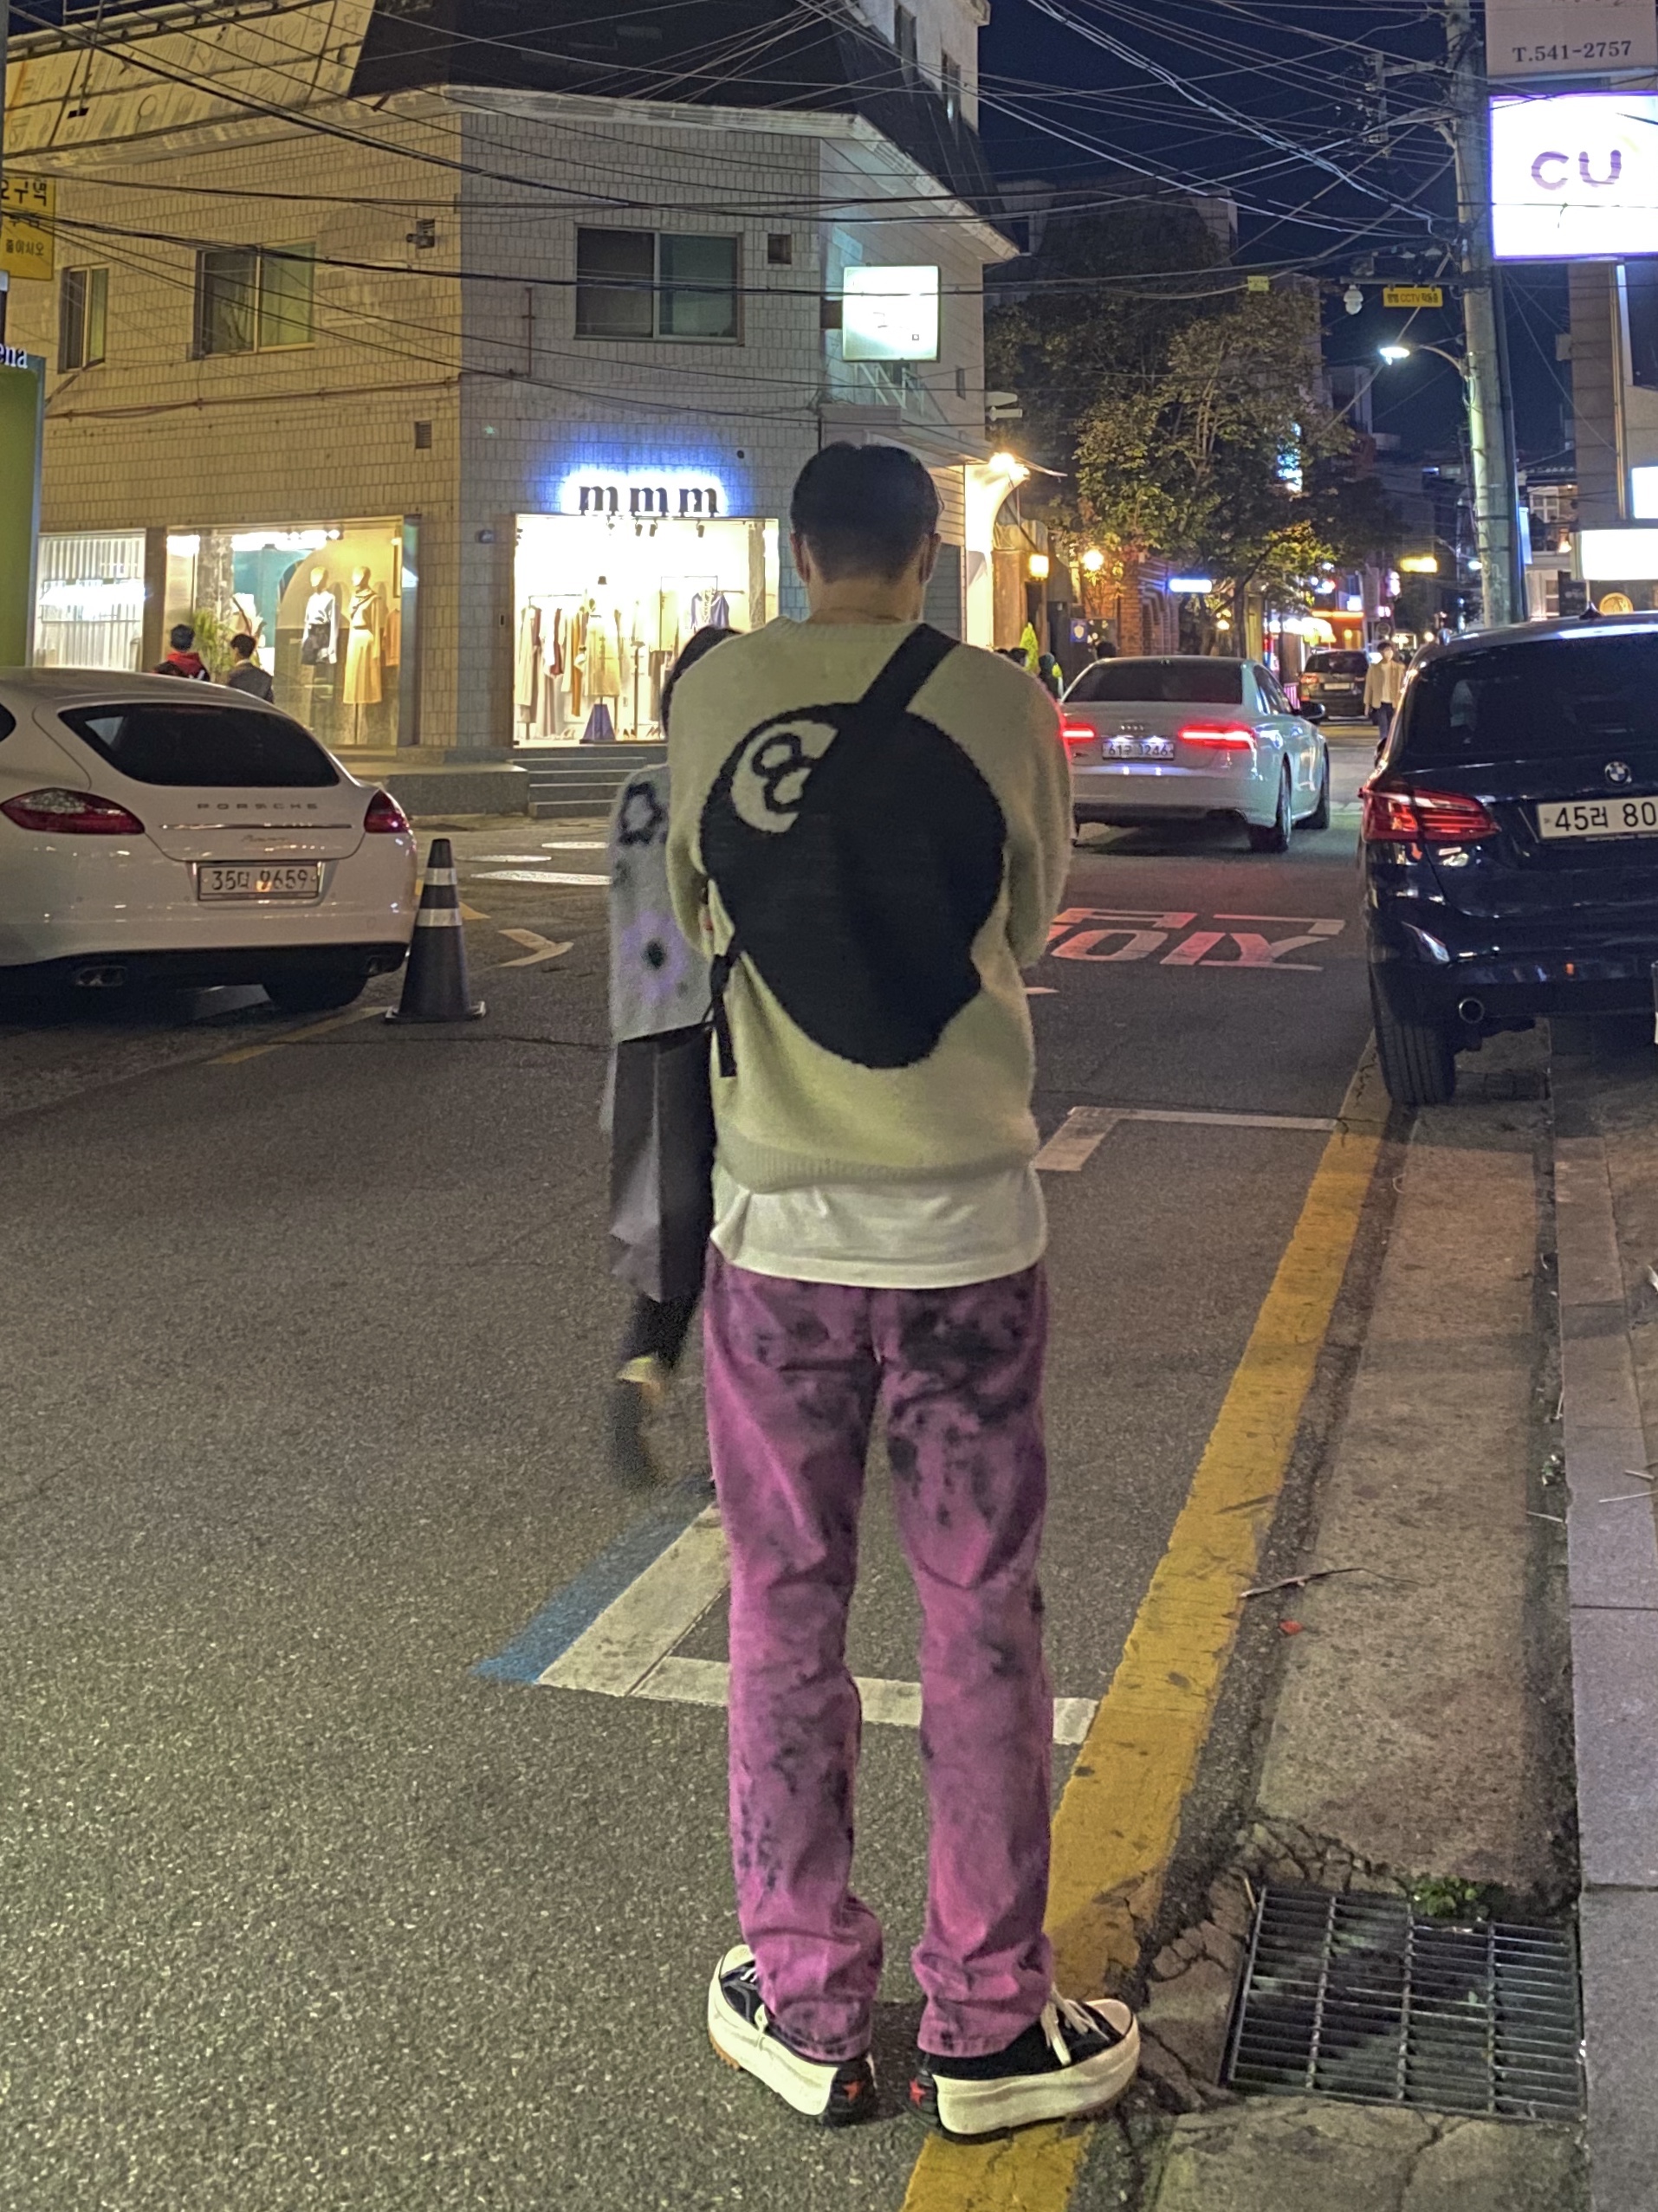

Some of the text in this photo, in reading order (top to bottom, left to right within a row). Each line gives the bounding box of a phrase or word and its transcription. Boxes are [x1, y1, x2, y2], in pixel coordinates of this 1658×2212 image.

[1512, 40, 1632, 63] T.541-2757
[1531, 149, 1622, 191] CU
[1400, 293, 1421, 303] CCTV
[1555, 806, 1609, 831] 45러
